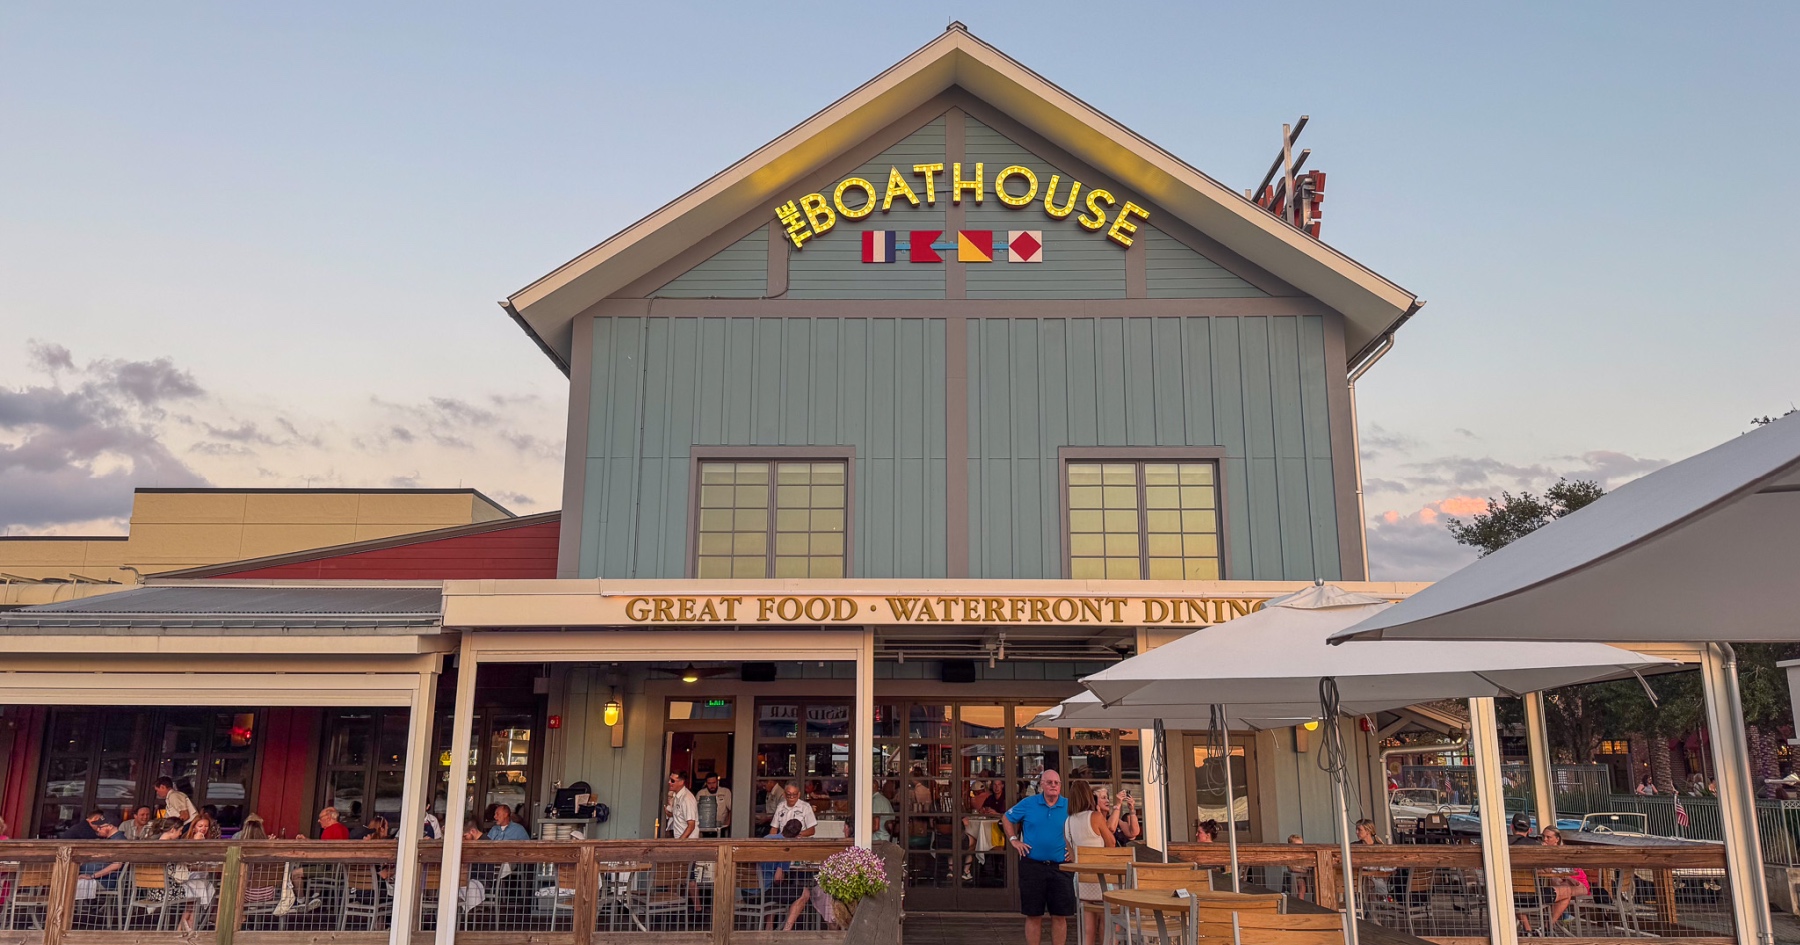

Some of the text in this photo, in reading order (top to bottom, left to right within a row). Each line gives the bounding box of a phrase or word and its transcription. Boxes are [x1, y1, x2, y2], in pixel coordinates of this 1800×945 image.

[774, 161, 1150, 250] THE BOATHOUSE
[625, 597, 742, 622] GREAT
[756, 597, 858, 622] FOOD
[885, 597, 1128, 623] WATERFRONT
